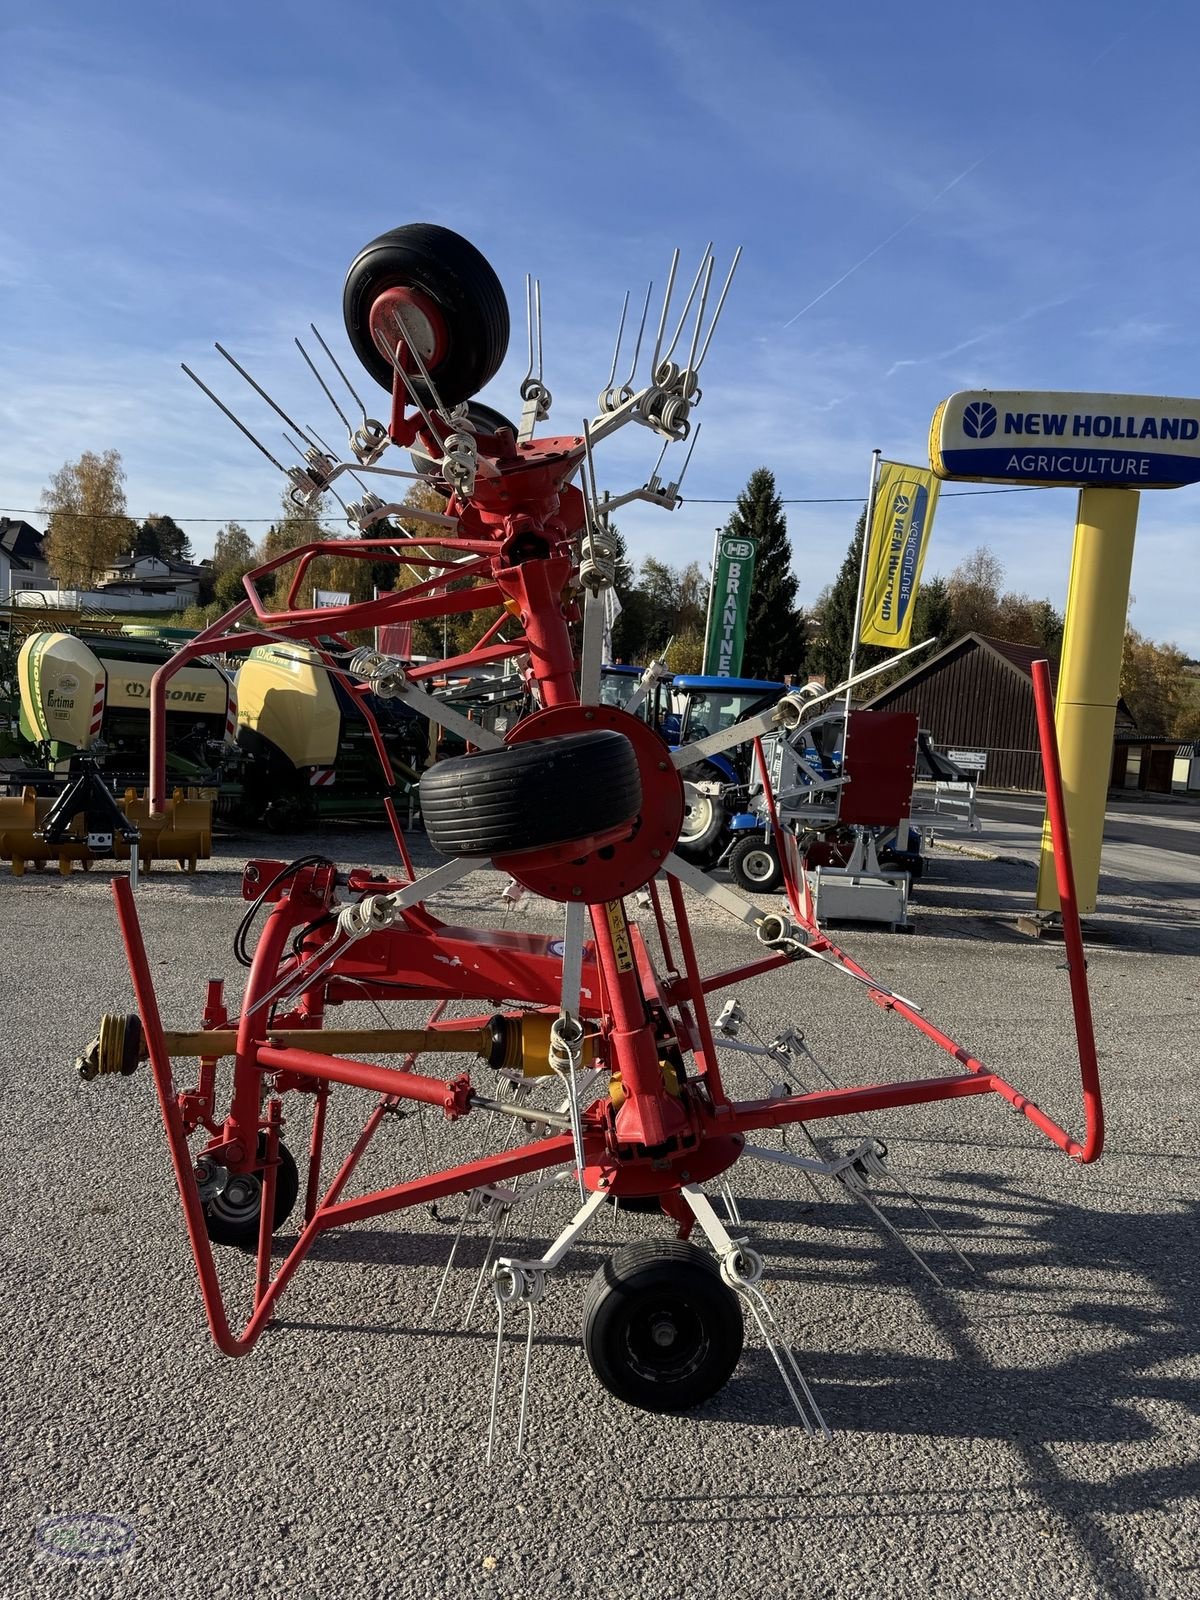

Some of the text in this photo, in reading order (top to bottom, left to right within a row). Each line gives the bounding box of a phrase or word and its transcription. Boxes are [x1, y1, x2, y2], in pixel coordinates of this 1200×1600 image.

[1004, 412, 1199, 440] NEW HOLLAND
[1006, 454, 1150, 476] AGRICULTURE
[47, 689, 75, 709] Fortima
